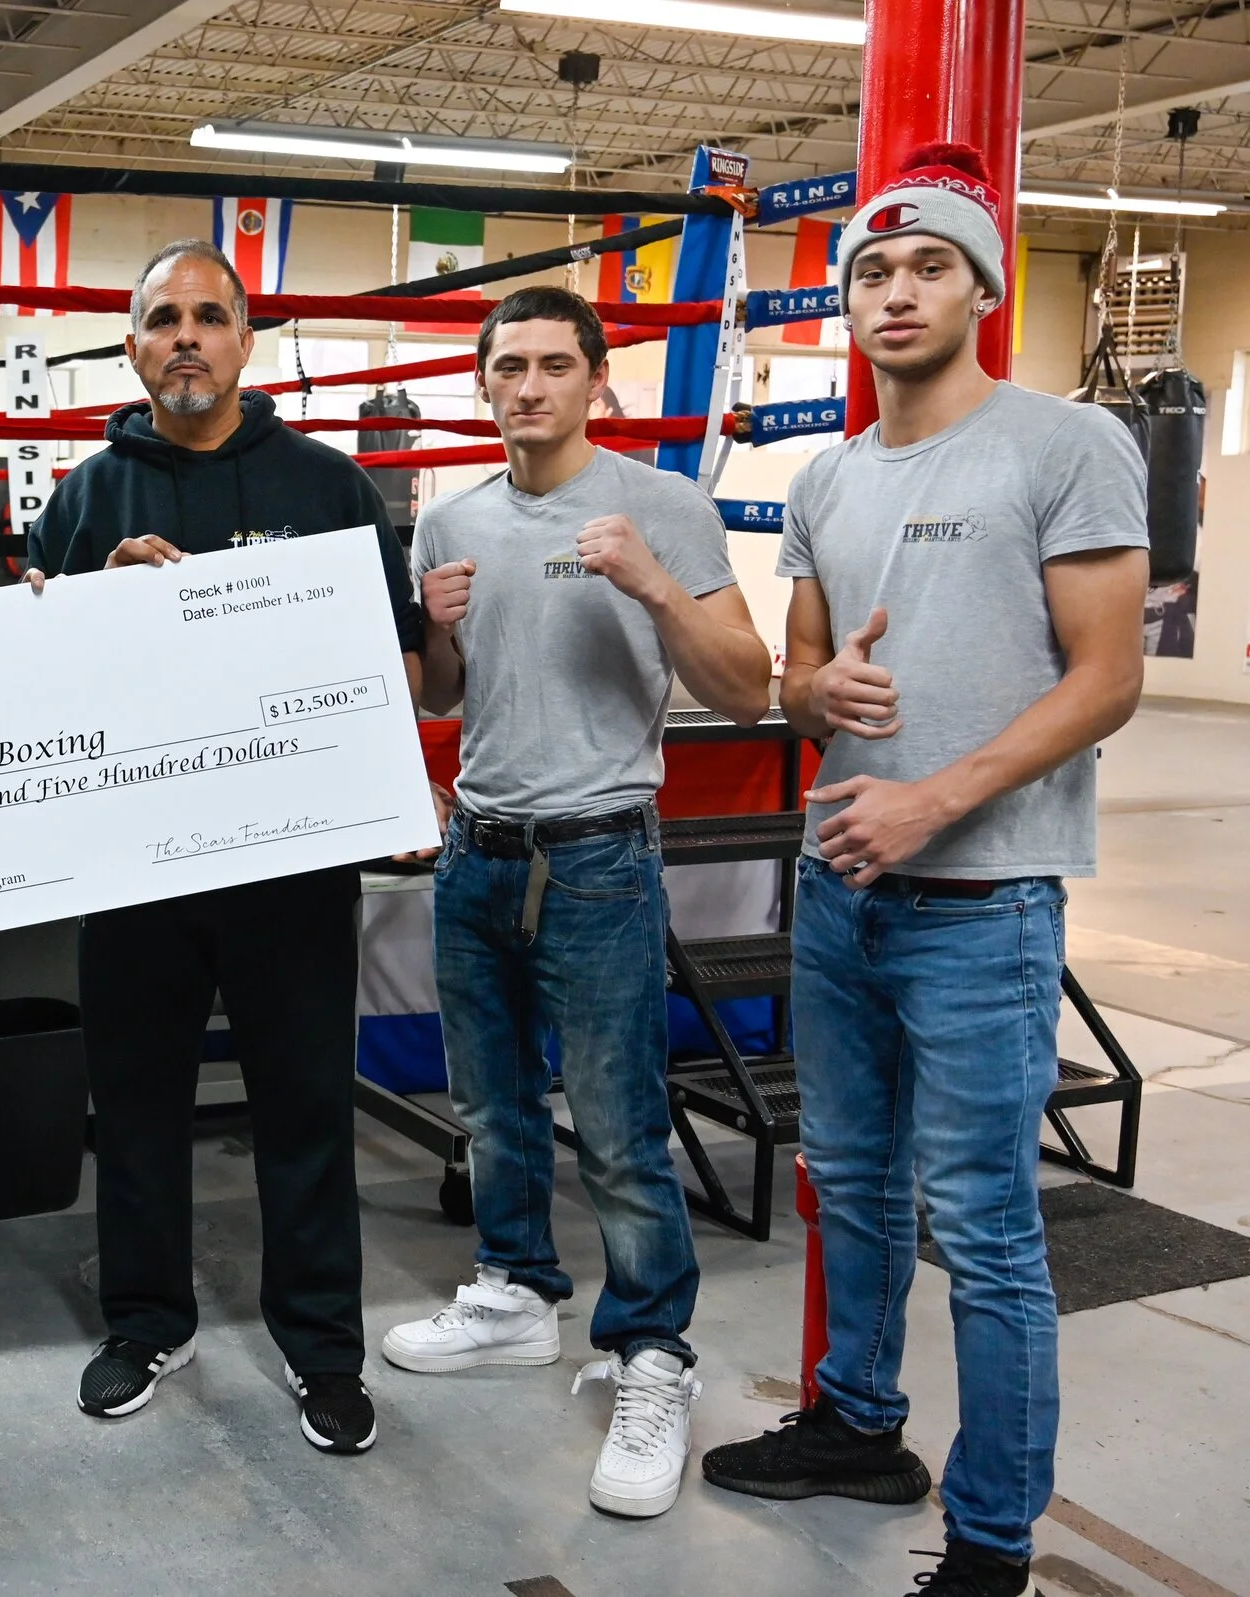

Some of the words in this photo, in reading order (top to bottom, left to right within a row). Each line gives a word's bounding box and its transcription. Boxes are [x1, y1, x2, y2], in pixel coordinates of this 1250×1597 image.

[711, 156, 745, 178] RINGSIDE
[773, 181, 849, 204] RING
[768, 295, 840, 311] RING
[762, 409, 837, 427] RING
[1158, 406, 1186, 415] TKO
[902, 522, 964, 538] THRIVE
[543, 561, 597, 574] THRIV
[179, 584, 222, 602] Check
[225, 582, 233, 594] #
[236, 575, 271, 591] 01001
[183, 607, 218, 622] Date:
[222, 596, 282, 615] December
[286, 592, 303, 604] 14,
[305, 585, 334, 600] 2019
[35, 775, 90, 804] Five
[97, 747, 208, 788] Hundred
[213, 736, 299, 766] Dollars
[146, 837, 185, 859] The
[184, 832, 237, 855] Scars
[238, 816, 334, 843] Foundation
